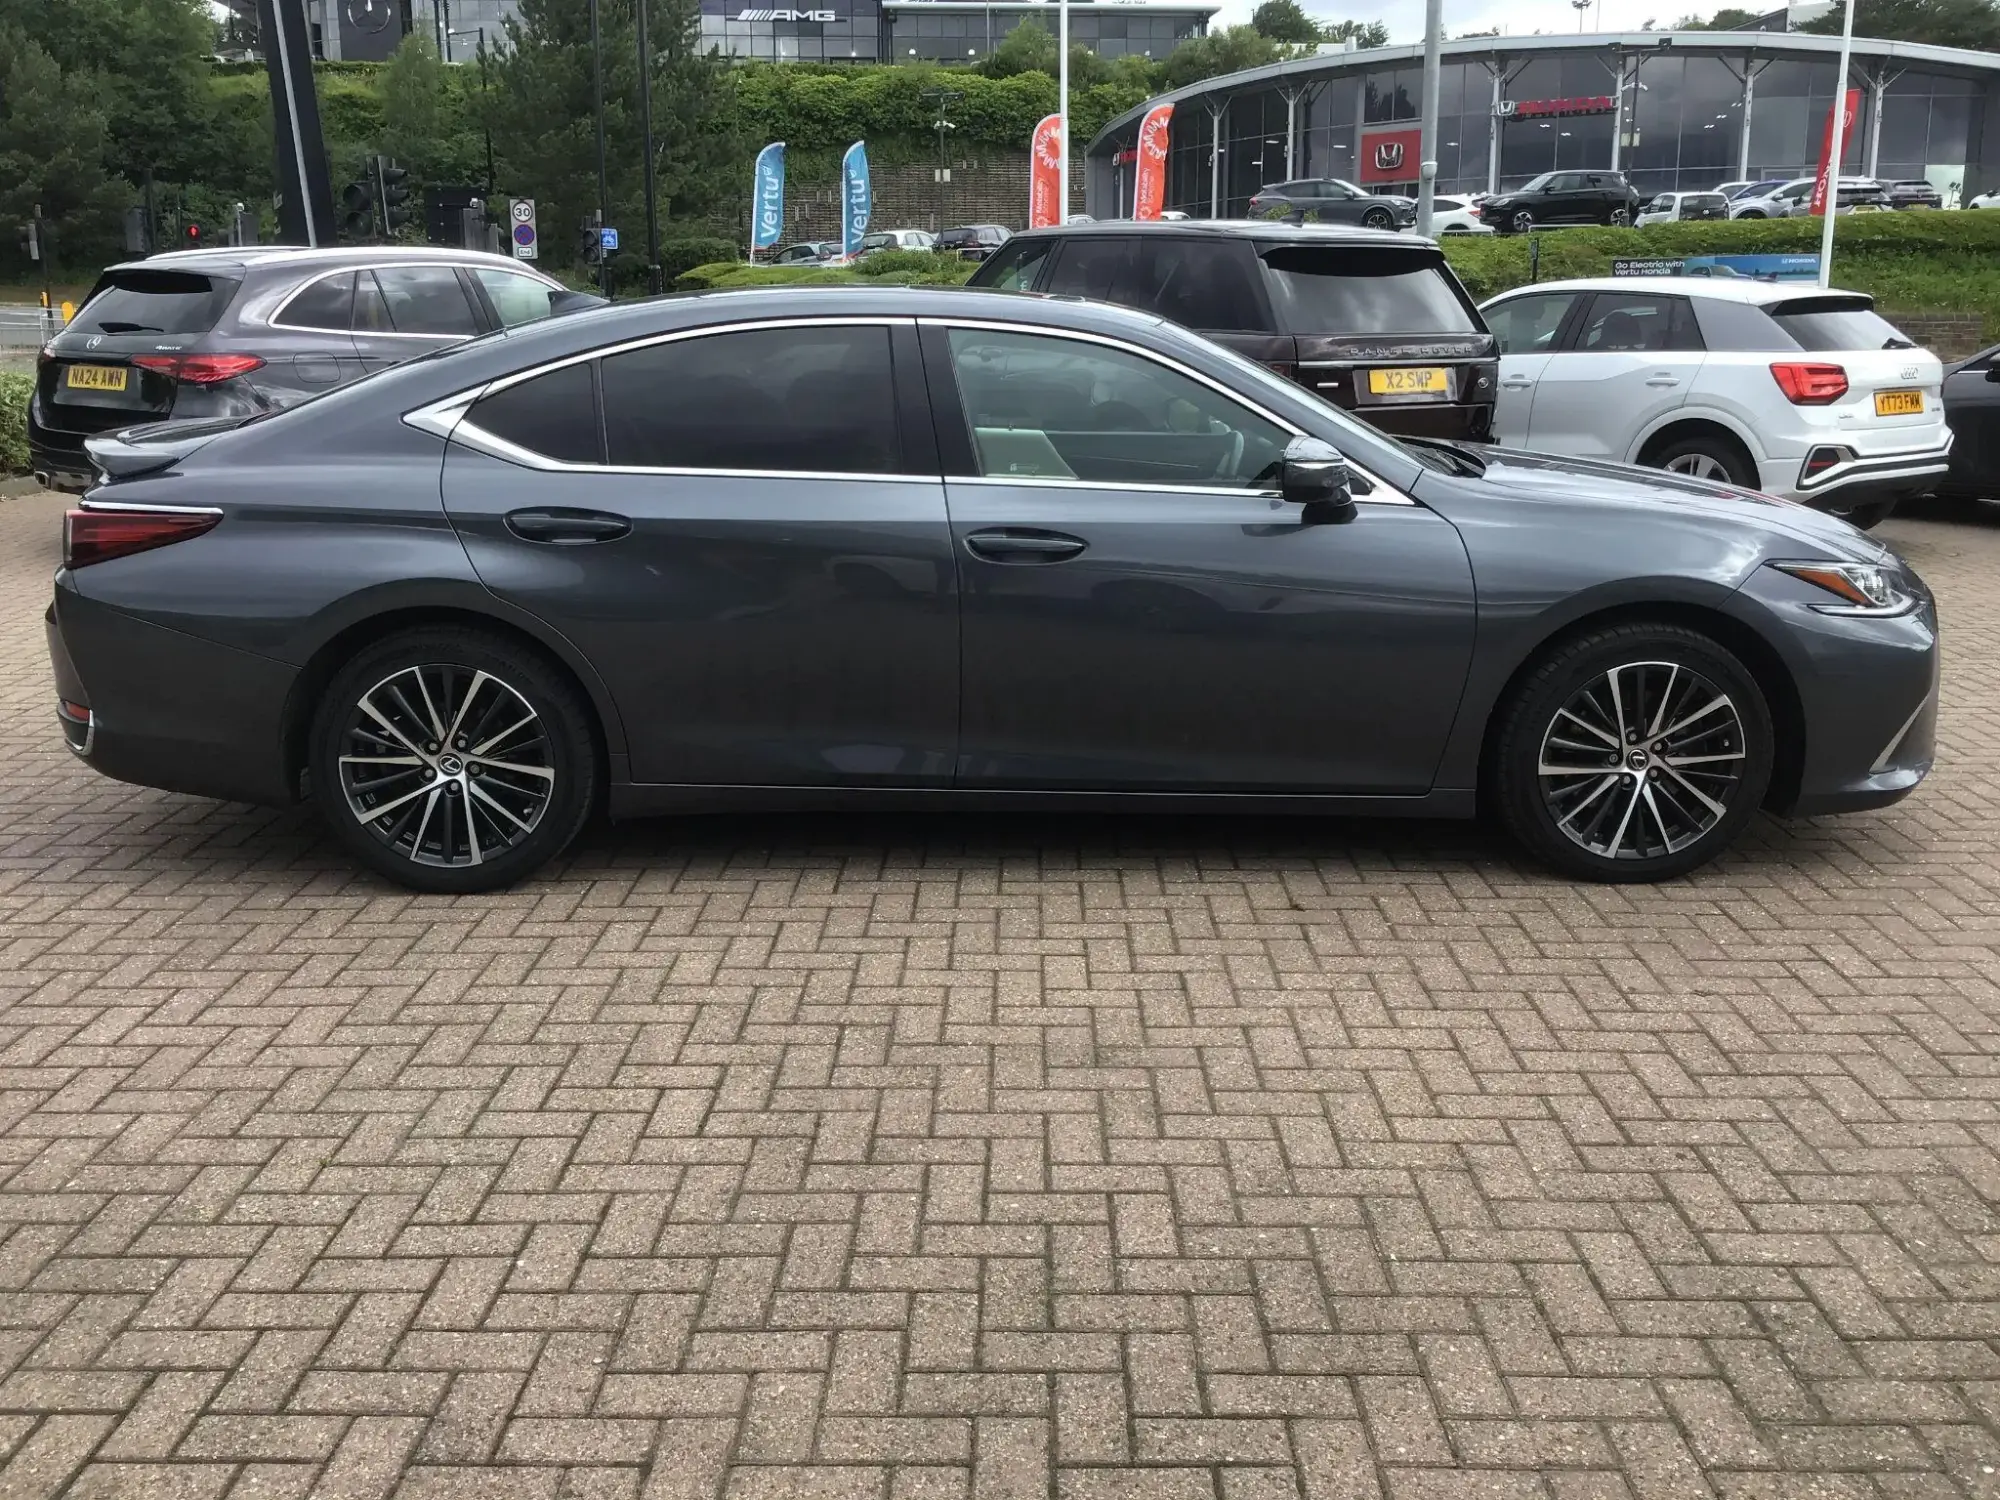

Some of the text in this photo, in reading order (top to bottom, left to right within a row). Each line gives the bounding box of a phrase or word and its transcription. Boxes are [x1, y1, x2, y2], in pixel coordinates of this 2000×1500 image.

[768, 9, 836, 22] AMG
[515, 207, 531, 217] 30
[760, 176, 779, 239] Vertu
[850, 179, 868, 245] Vertu
[1615, 267, 1671, 276] Vertu Honda
[1629, 261, 1663, 269] Electric
[1665, 260, 1686, 268] with
[72, 368, 98, 386] NA24
[1385, 371, 1433, 389] X2 SWP
